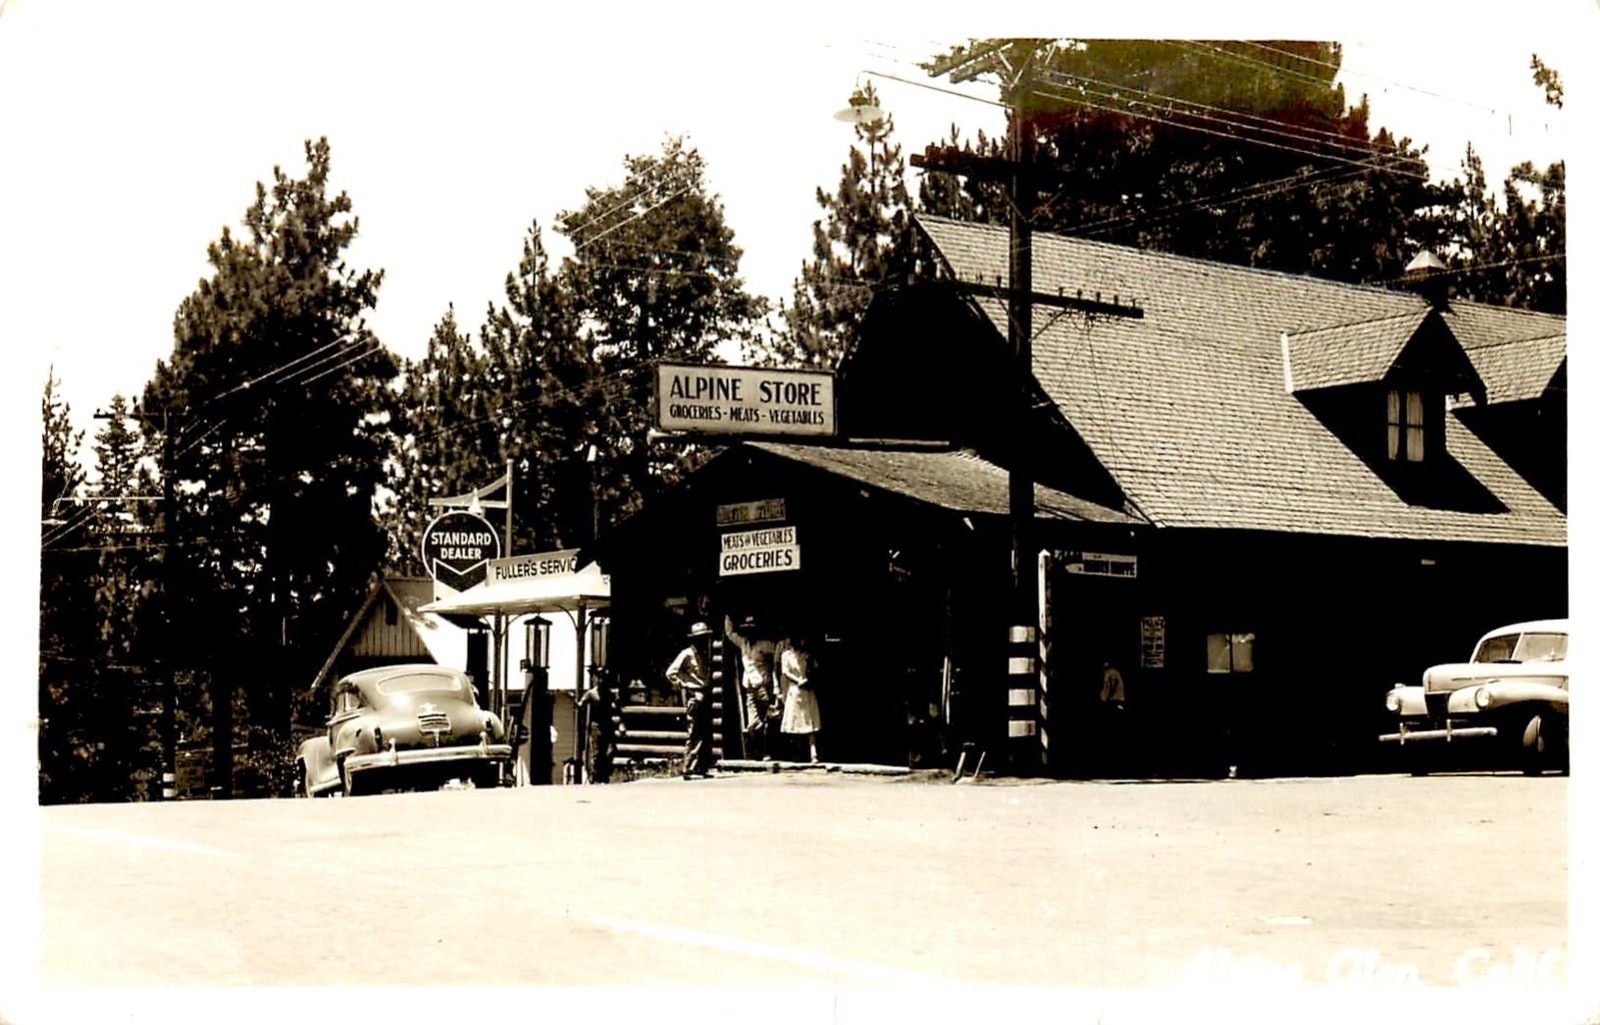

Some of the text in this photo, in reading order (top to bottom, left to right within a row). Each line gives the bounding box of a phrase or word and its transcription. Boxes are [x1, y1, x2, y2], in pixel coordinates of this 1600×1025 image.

[670, 375, 822, 405] ALPINE STORE
[670, 404, 722, 420] GROCERIES
[730, 407, 760, 422] MEATS
[769, 409, 824, 425] VEGETABLES
[431, 532, 492, 546] STANDARD
[724, 534, 744, 549] MEATS
[751, 528, 792, 547] VEGETABLES
[441, 547, 482, 560] DEALER
[723, 549, 792, 571] GROCERIES
[496, 559, 538, 579] FULLER'S
